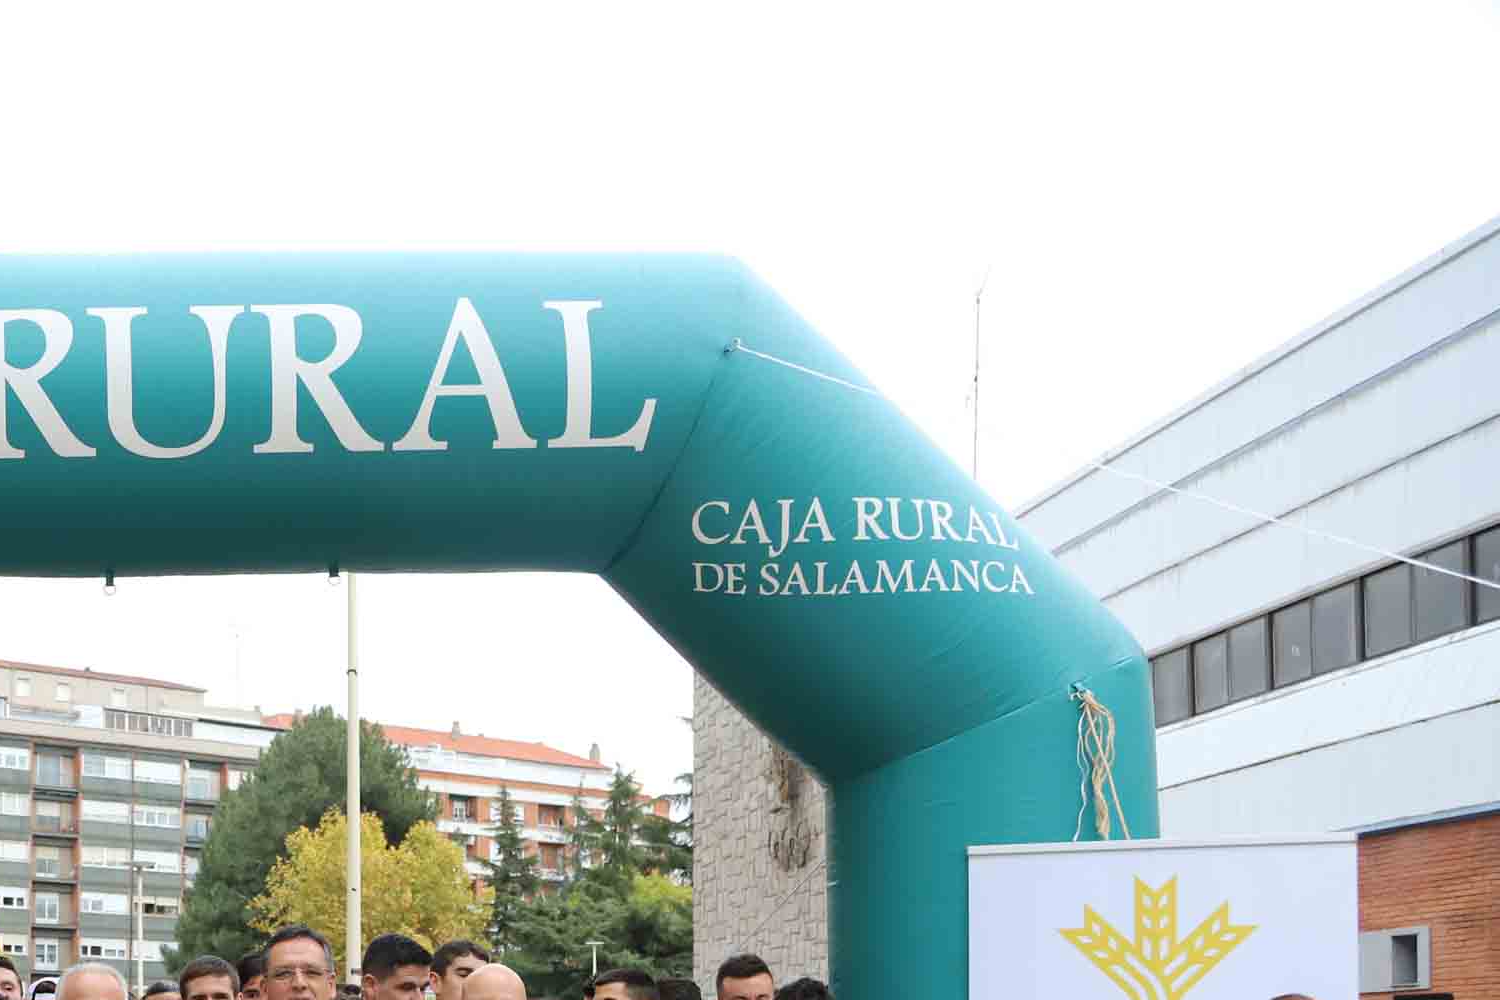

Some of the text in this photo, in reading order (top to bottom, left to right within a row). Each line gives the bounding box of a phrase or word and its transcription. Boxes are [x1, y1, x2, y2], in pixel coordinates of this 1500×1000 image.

[692, 497, 1020, 558] CAJA RURAL
[692, 559, 1036, 596] DE SALAMANCA
